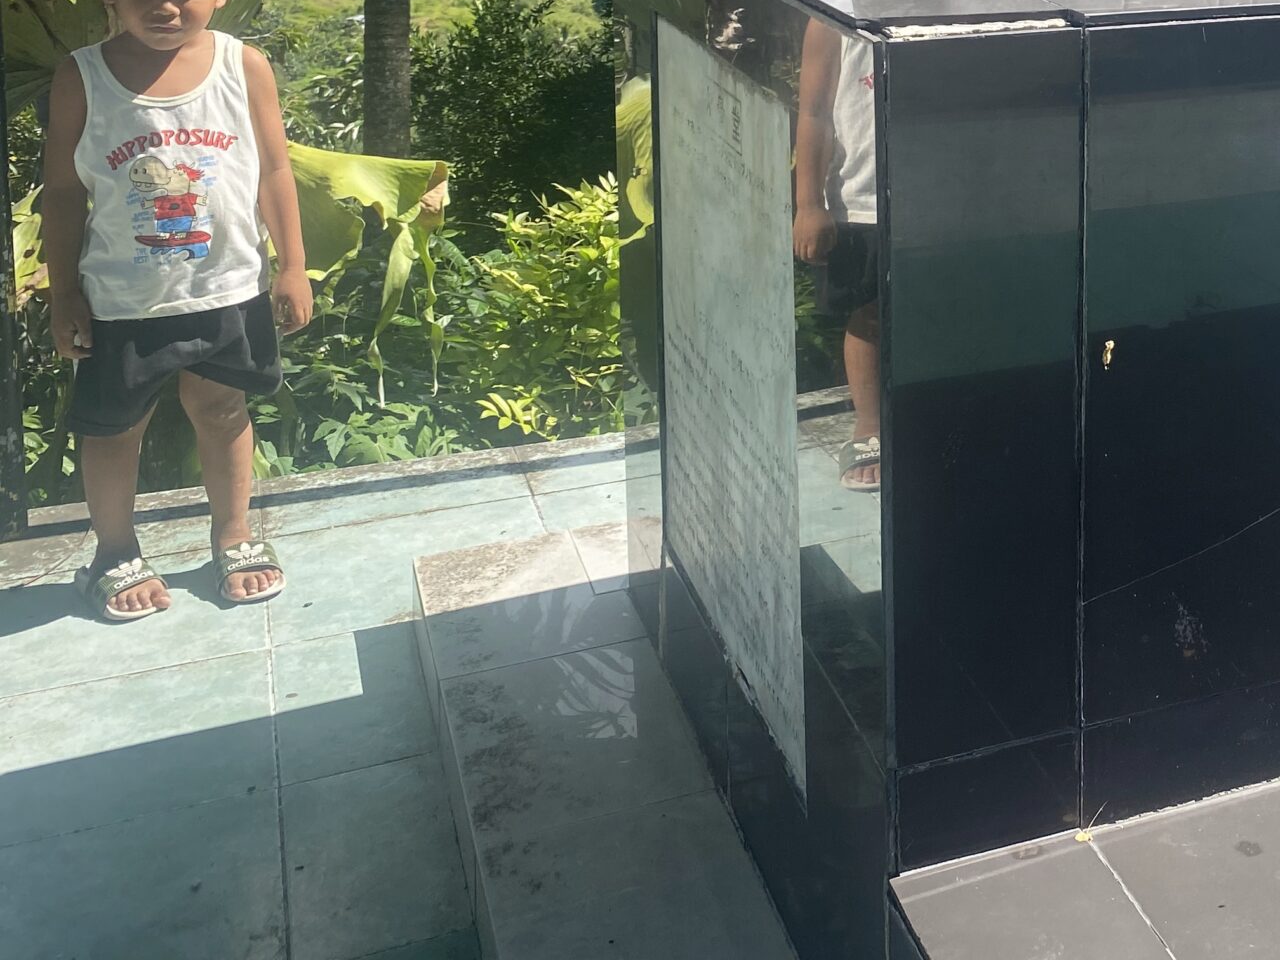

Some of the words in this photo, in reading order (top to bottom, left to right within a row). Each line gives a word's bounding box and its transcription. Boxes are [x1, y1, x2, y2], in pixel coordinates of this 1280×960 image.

[106, 128, 238, 170] HIPPOPOSURF
[228, 556, 269, 571] adidas
[113, 568, 154, 590] adidas
